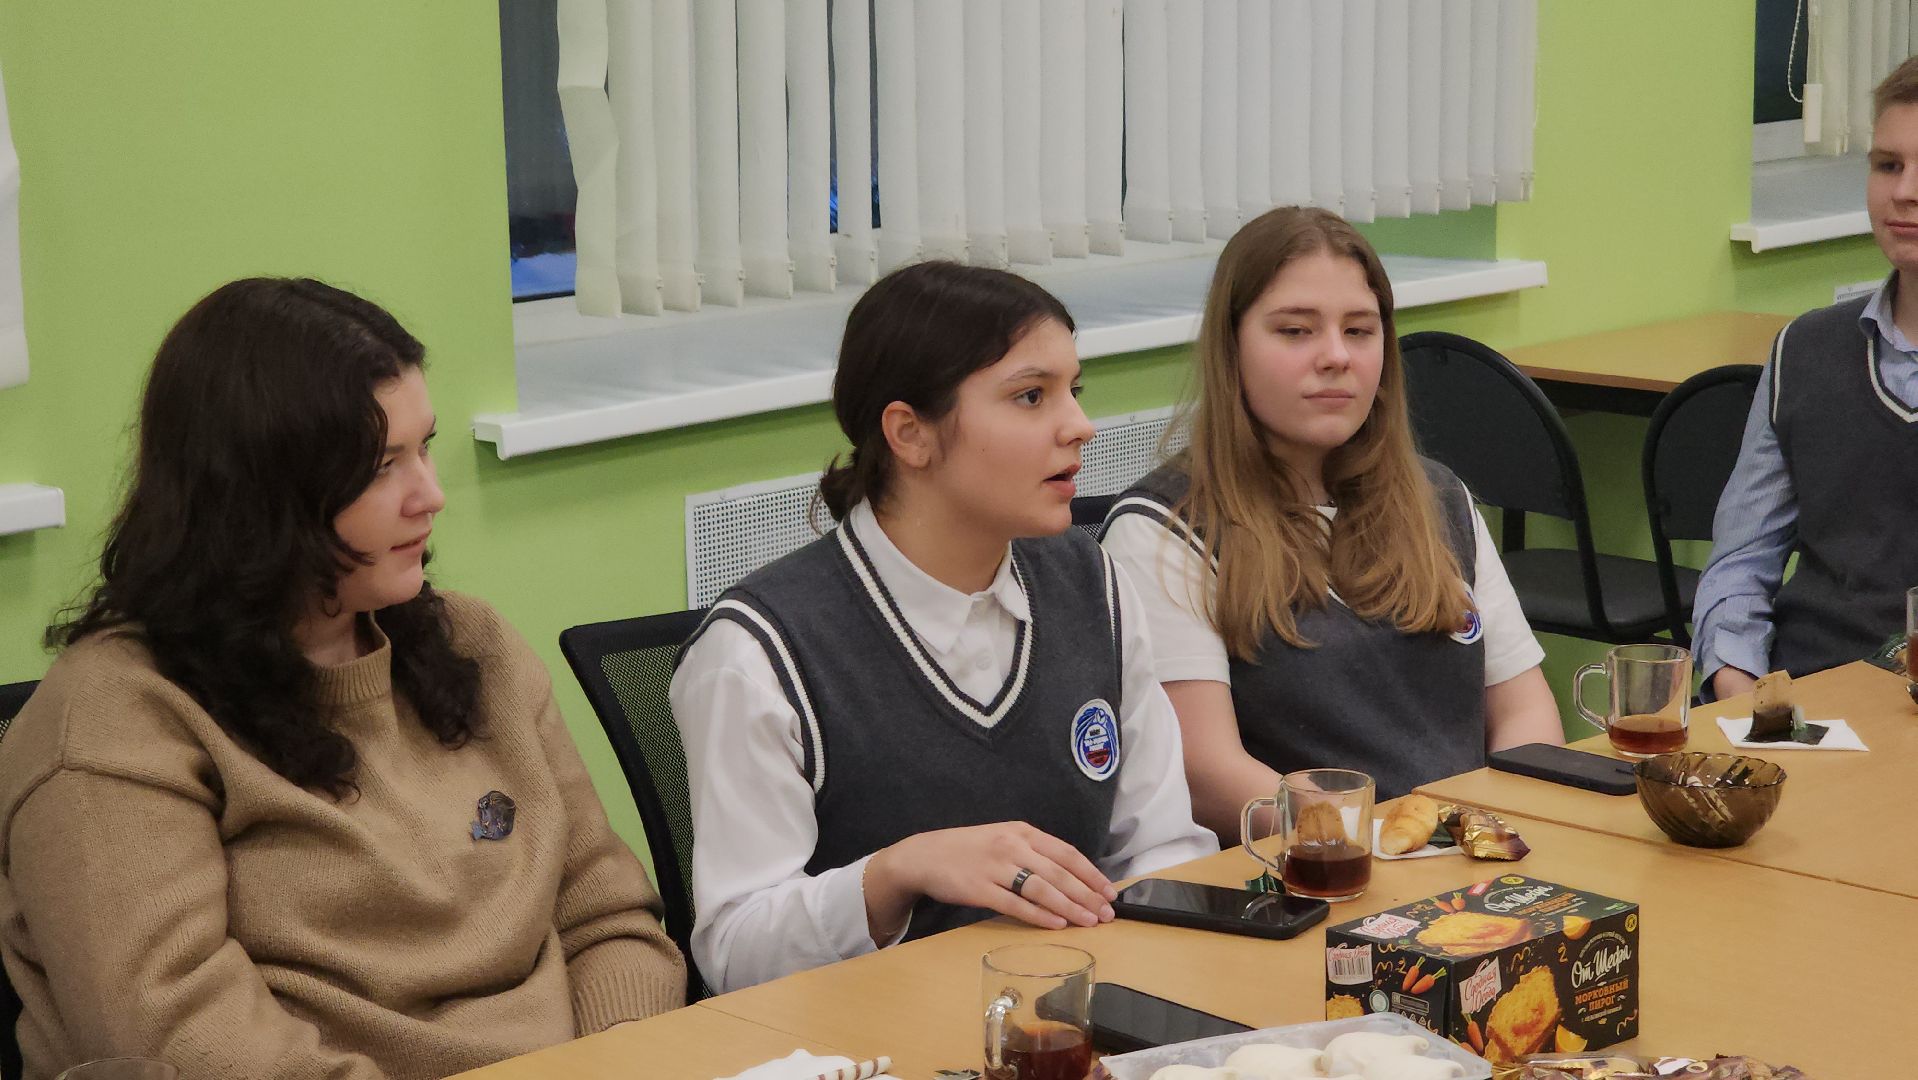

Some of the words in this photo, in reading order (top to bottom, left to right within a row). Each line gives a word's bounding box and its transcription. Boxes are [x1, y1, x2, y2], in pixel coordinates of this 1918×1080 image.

[1571, 960, 1594, 988] От
[1593, 944, 1632, 976] Шефа
[1575, 978, 1629, 1005] МОРКОВНЫЙ
[1589, 995, 1616, 1011] ПИРОГ
